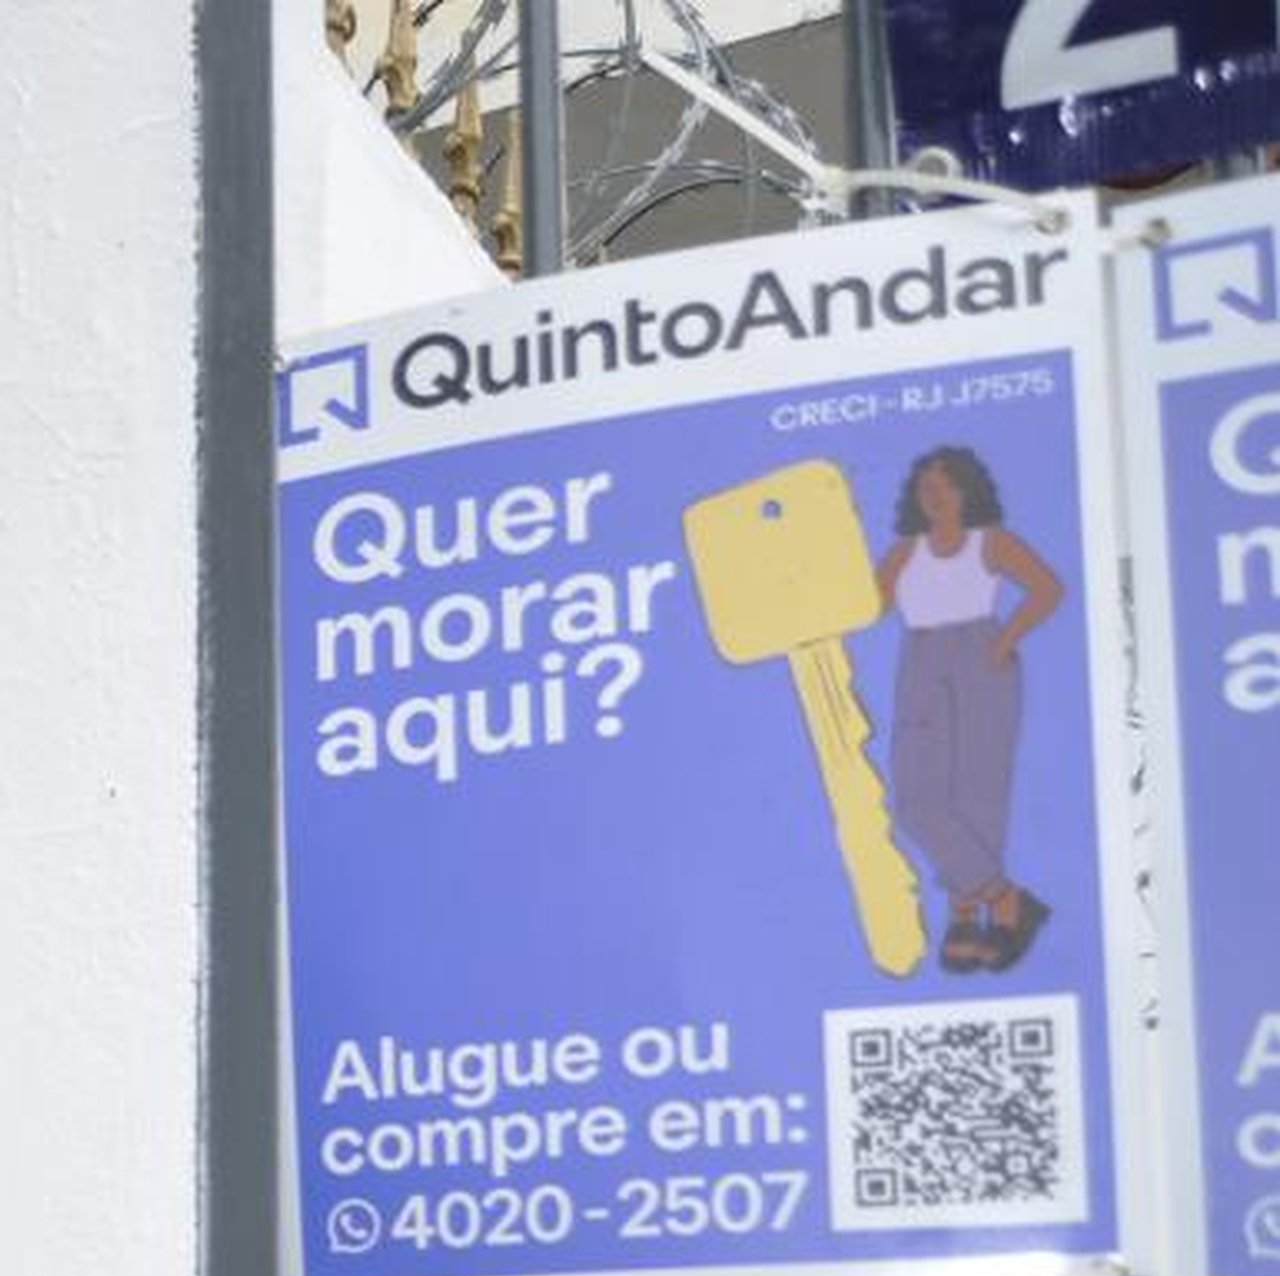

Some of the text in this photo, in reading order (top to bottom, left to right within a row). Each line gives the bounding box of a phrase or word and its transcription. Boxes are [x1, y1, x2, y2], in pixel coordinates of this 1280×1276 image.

[391, 246, 1068, 410] QuintoAndar
[313, 472, 612, 584] Quer
[315, 560, 676, 682] morar
[315, 642, 644, 782] aqui?
[322, 1023, 730, 1108] Alugue ou
[322, 1093, 808, 1178] compre em:
[391, 1169, 809, 1249] 4020-2507
